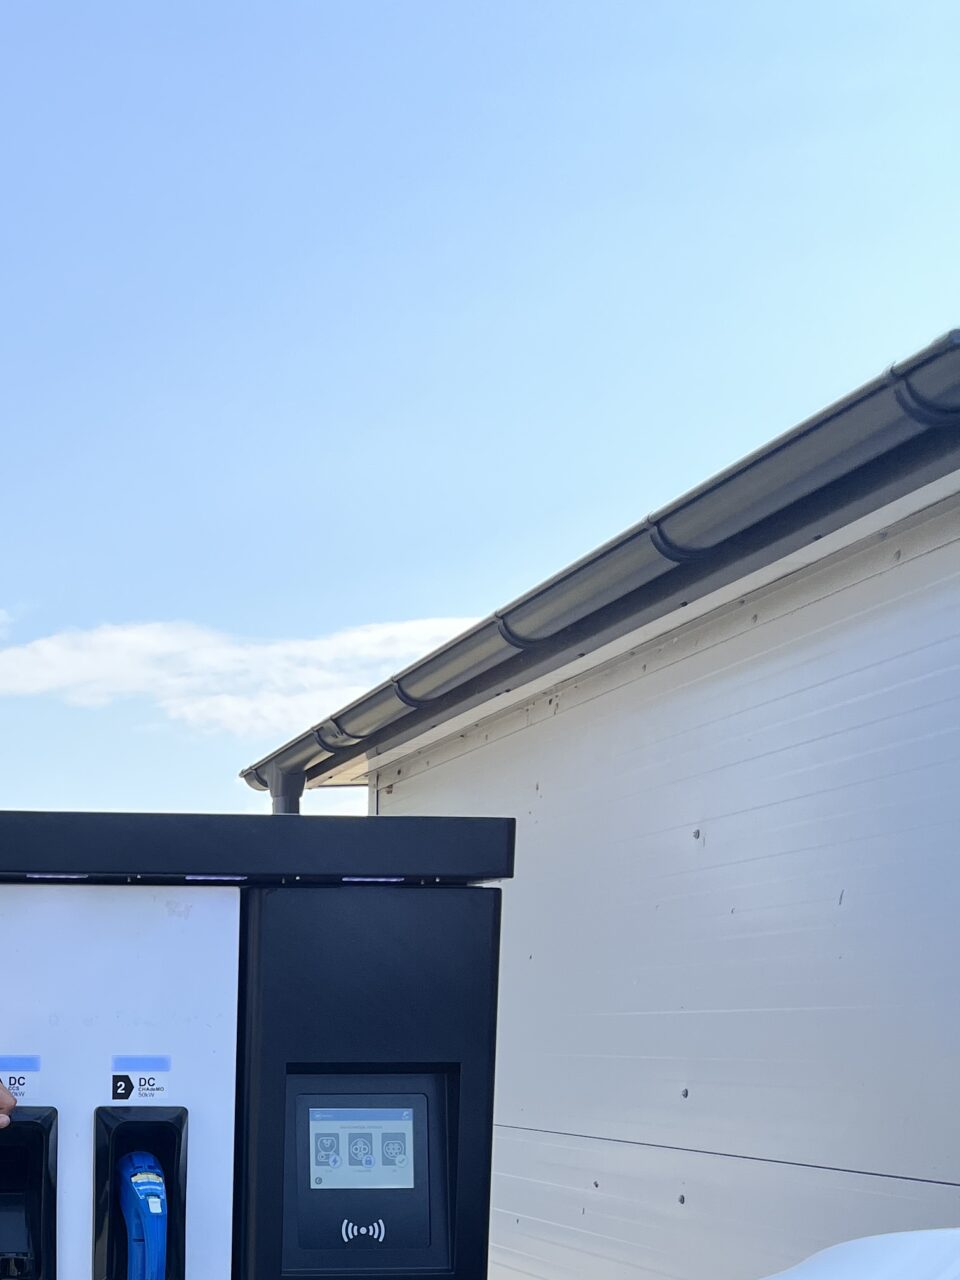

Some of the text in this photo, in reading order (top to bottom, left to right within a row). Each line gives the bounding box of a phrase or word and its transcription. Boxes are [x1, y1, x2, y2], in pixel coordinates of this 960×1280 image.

[8, 1076, 26, 1086] DC
[138, 1077, 156, 1087] DC
[116, 1081, 126, 1094] 2
